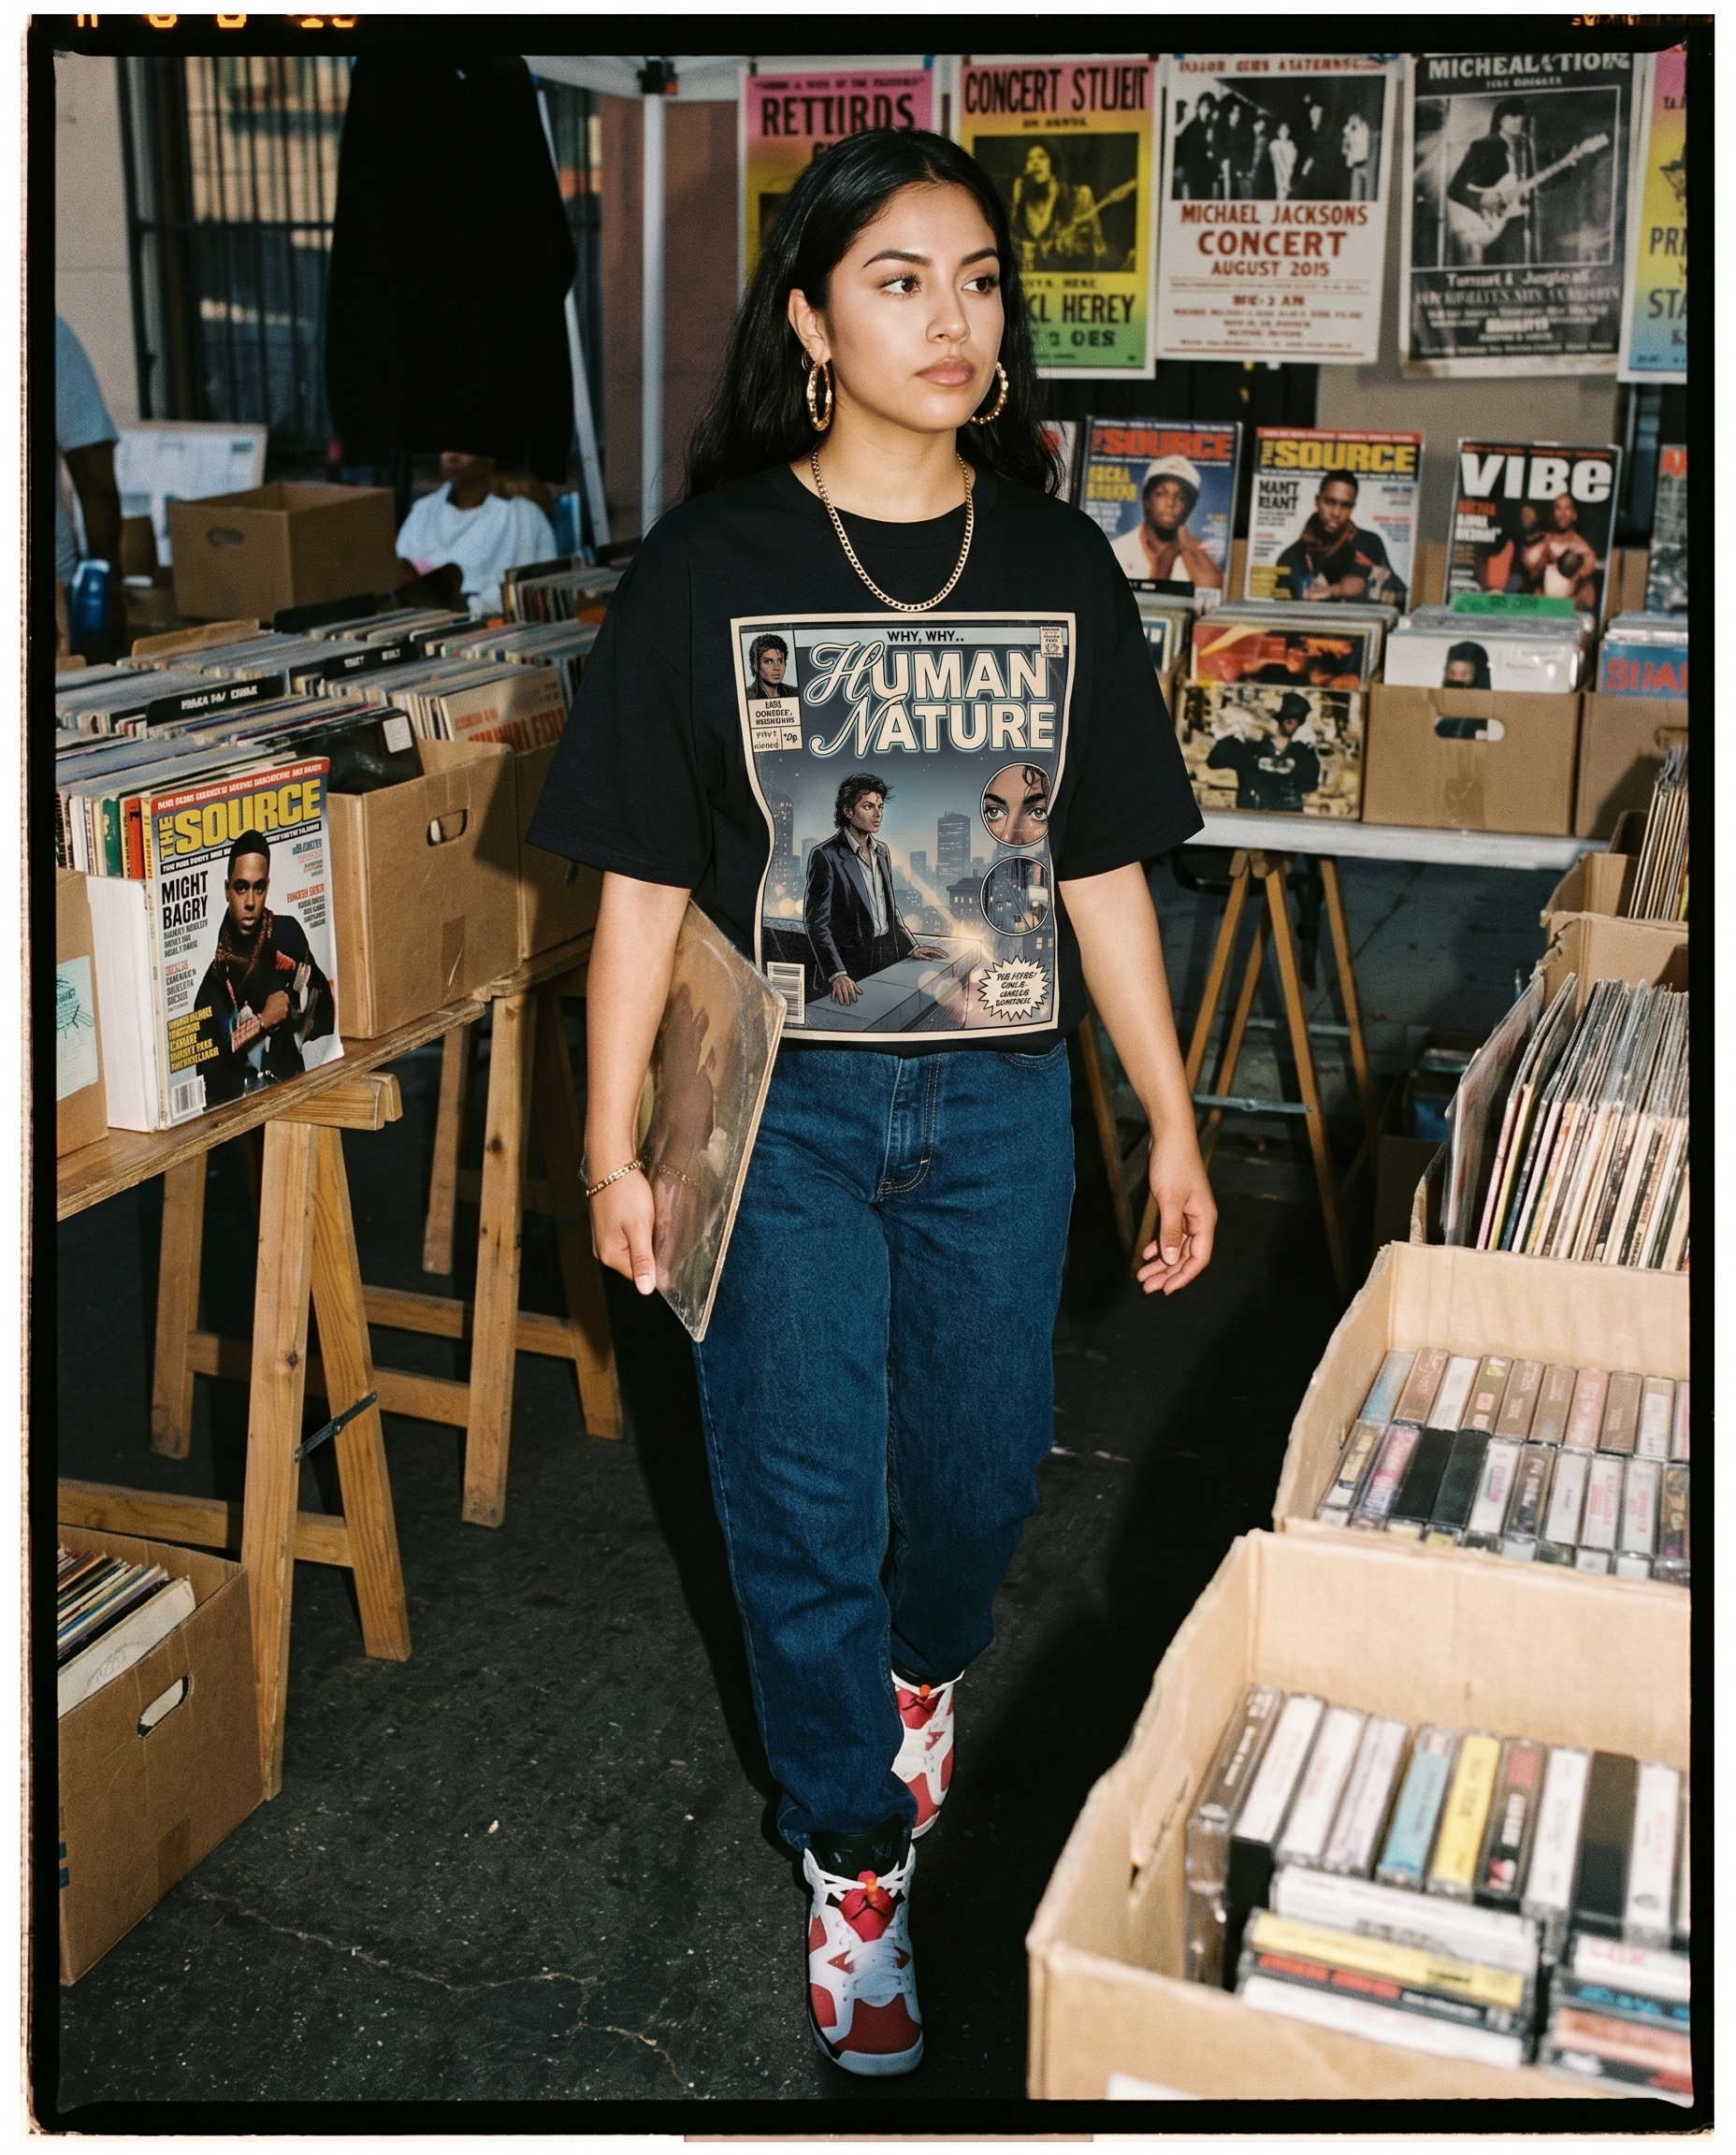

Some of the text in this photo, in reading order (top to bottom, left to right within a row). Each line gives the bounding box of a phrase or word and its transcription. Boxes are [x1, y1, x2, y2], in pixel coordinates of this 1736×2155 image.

[965, 68, 1062, 114] CONCERT
[1180, 204, 1368, 226] MICHAEL JACKSONS
[1197, 229, 1347, 257] CONCERT
[1211, 260, 1330, 277] AUGUST 2015
[1063, 294, 1135, 324] HEREY
[1103, 427, 1235, 461] SOURCE
[1273, 439, 1417, 474] SOURCE
[887, 629, 964, 644] WHY, WHY..
[805, 641, 1047, 703] HUMAN
[810, 693, 1054, 757] NATURE
[159, 815, 174, 861] THE
[174, 778, 322, 855] SOURCE
[161, 870, 209, 905] MIGHT
[162, 894, 209, 931] BAGRY
